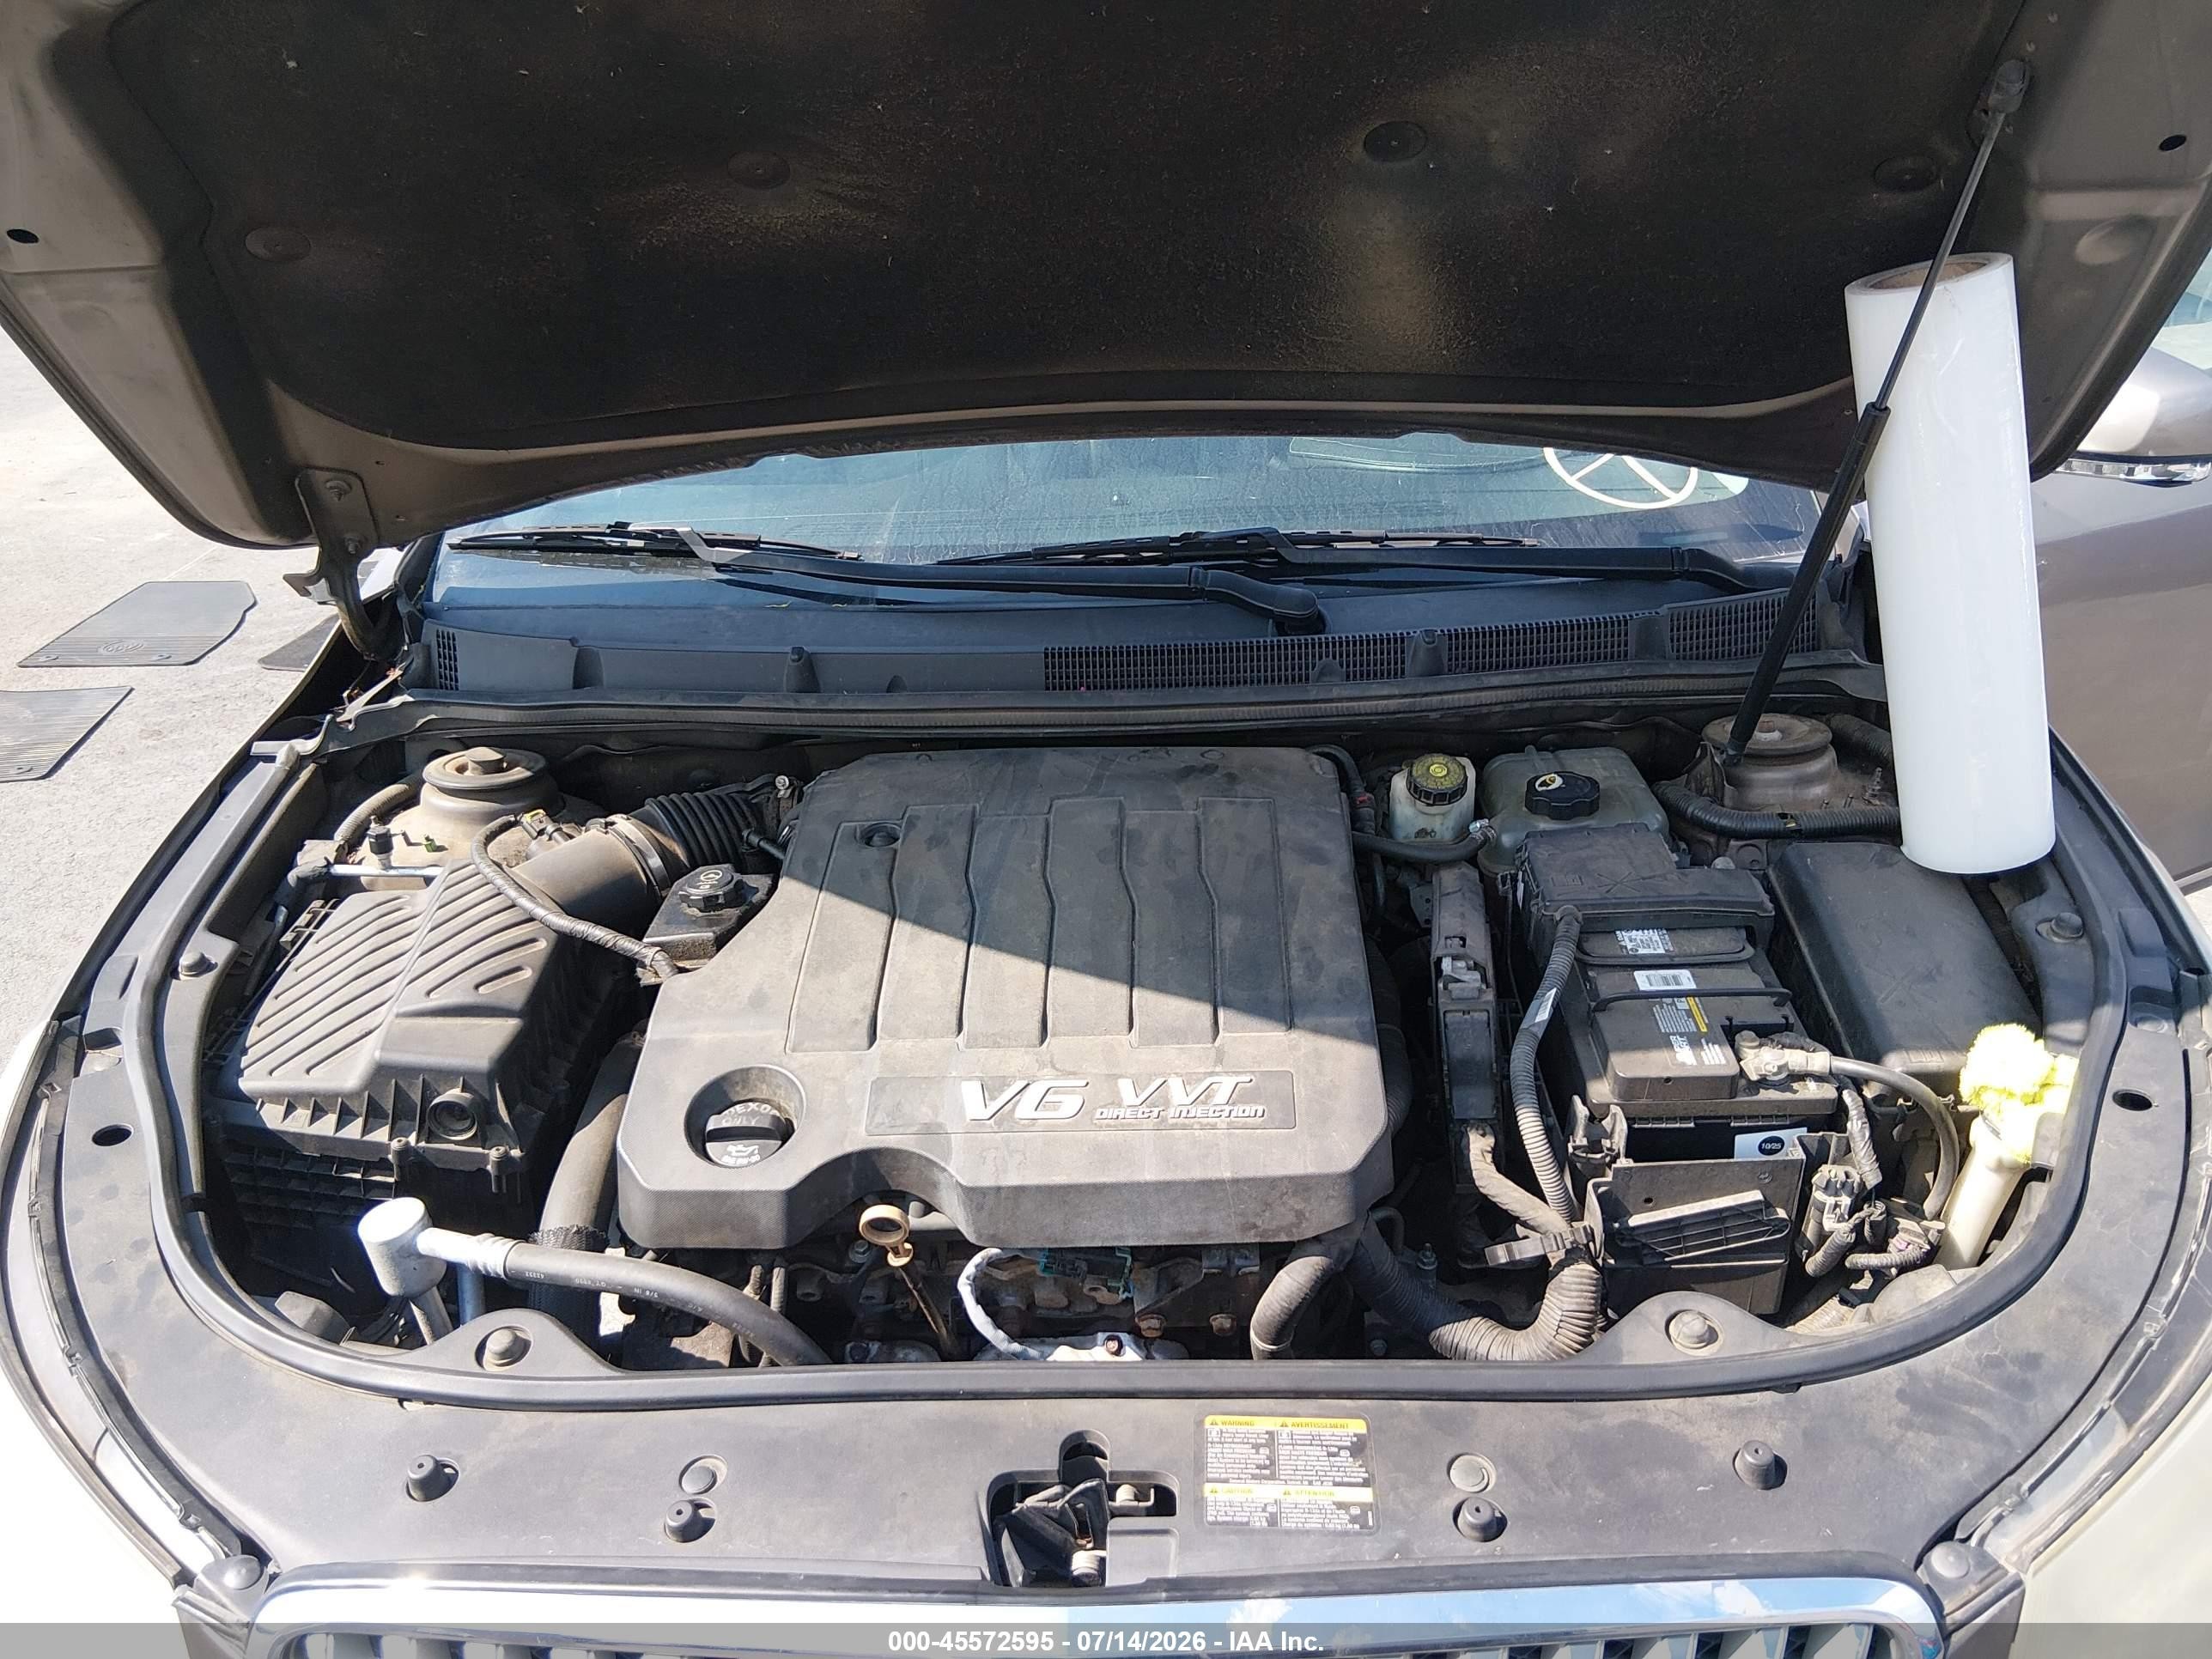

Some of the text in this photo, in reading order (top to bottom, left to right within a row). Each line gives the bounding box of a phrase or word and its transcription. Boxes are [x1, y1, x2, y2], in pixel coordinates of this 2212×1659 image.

[960, 1076, 1254, 1121] V6 VVT
[1095, 1104, 1267, 1120] DIRECT INJECTION
[721, 1116, 760, 1127] ONLY
